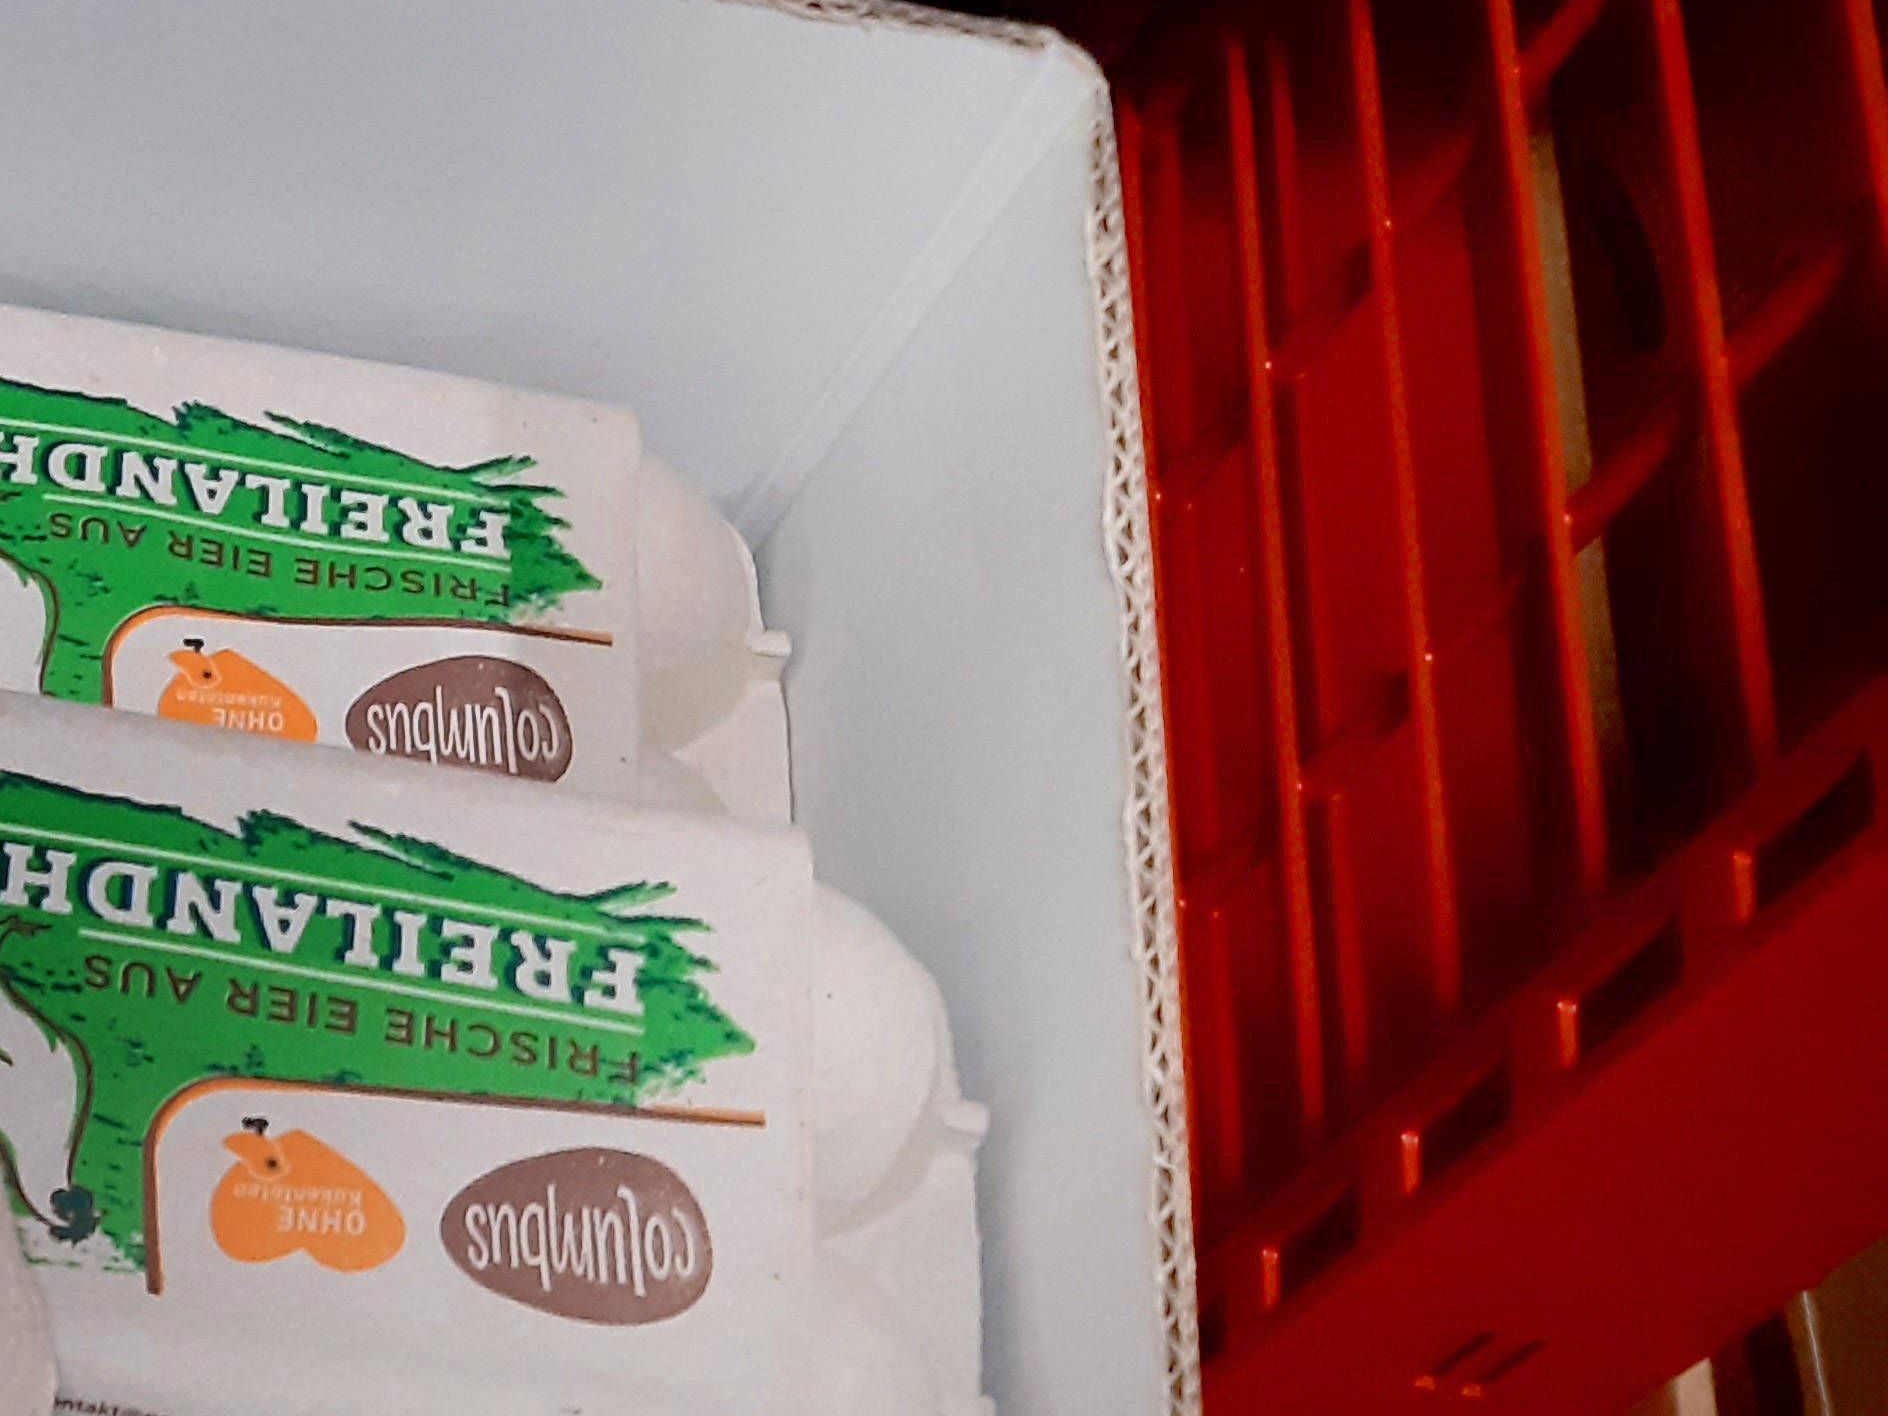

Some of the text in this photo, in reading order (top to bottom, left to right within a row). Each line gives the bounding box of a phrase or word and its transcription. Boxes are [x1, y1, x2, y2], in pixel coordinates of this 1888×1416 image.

[49, 512, 511, 607] FRISCHE EIER AUS
[211, 707, 286, 734] OHNE
[364, 684, 561, 770] columbus
[81, 950, 642, 1085] FRISCHE EIER AUS
[276, 1206, 366, 1236] OHNE
[463, 1184, 699, 1294] columbus
